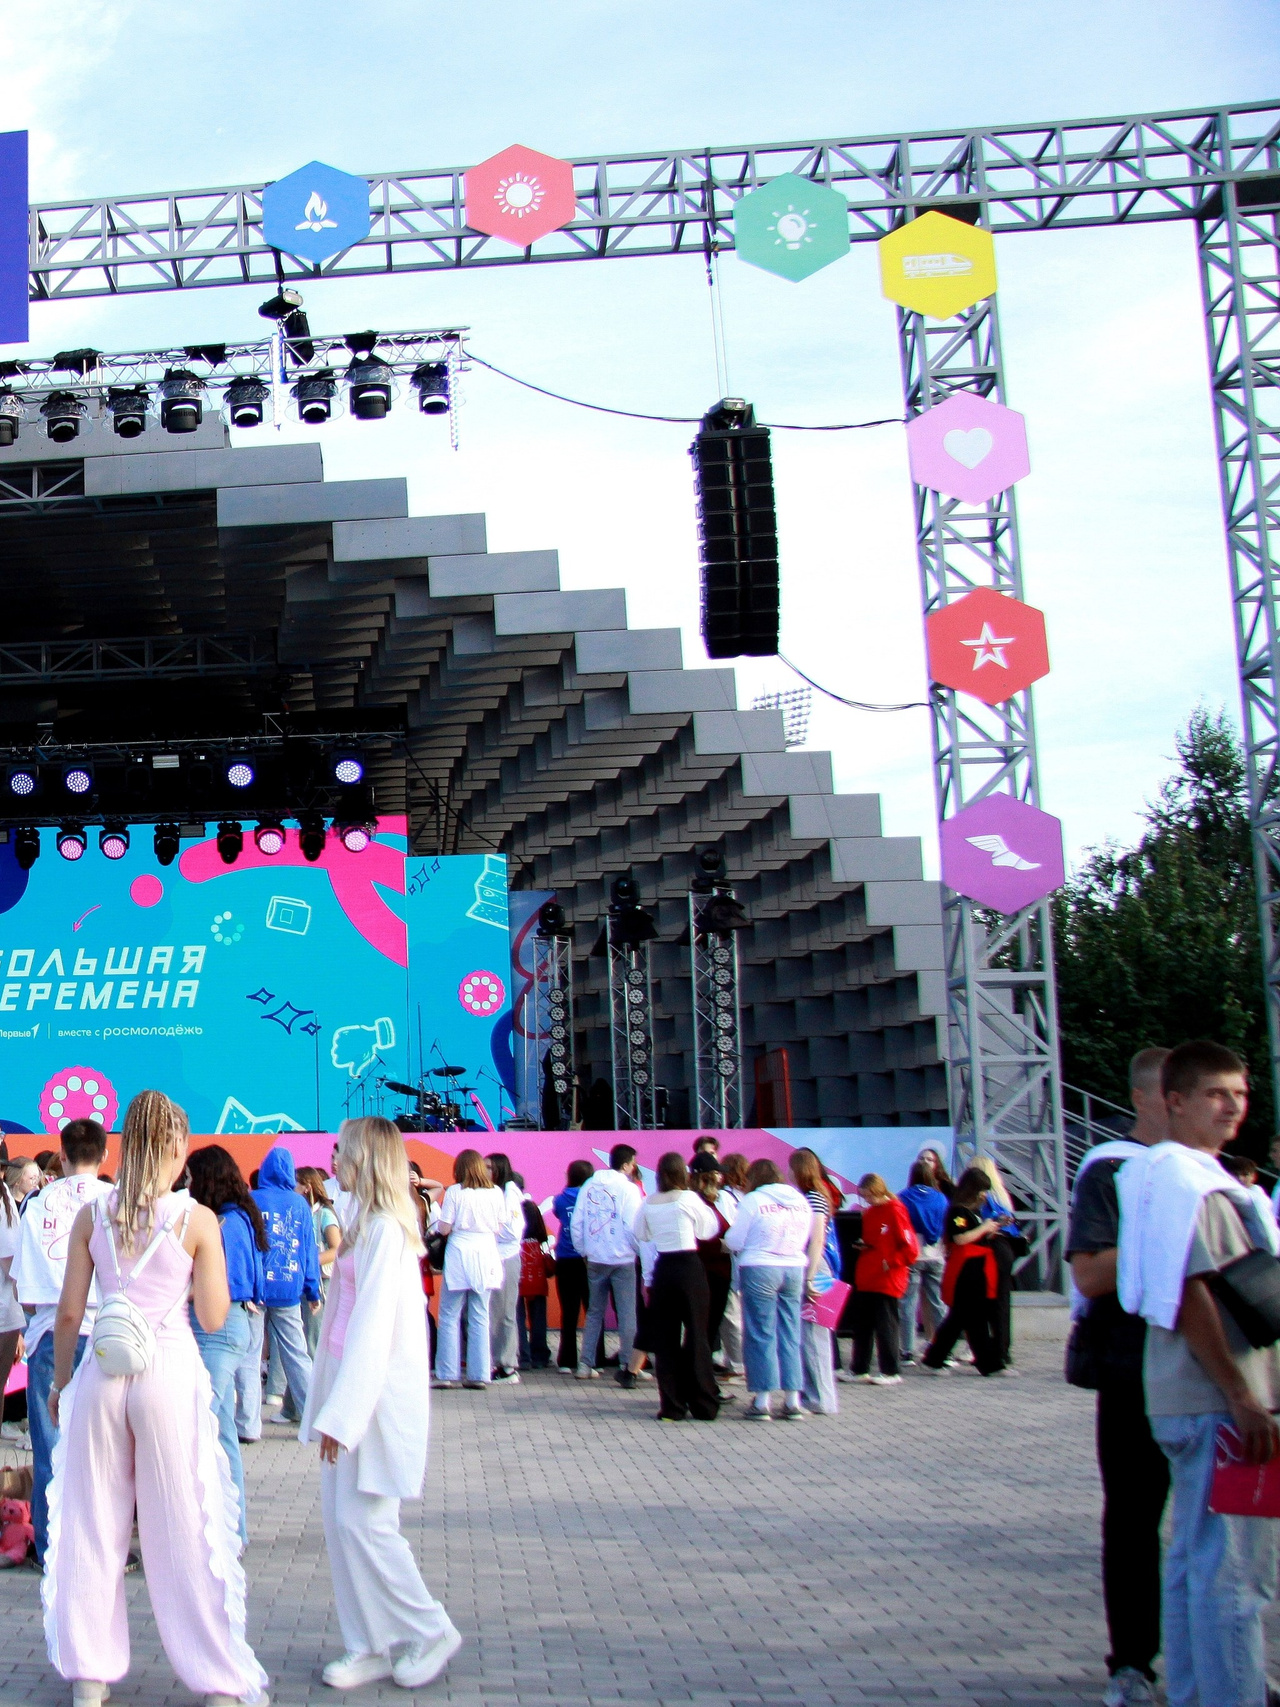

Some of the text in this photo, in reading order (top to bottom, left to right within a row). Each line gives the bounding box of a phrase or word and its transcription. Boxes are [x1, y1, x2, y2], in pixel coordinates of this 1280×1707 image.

[58, 1028, 92, 1037] вместе
[94, 1029, 101, 1037] с
[103, 1023, 203, 1040] росмолодёжь
